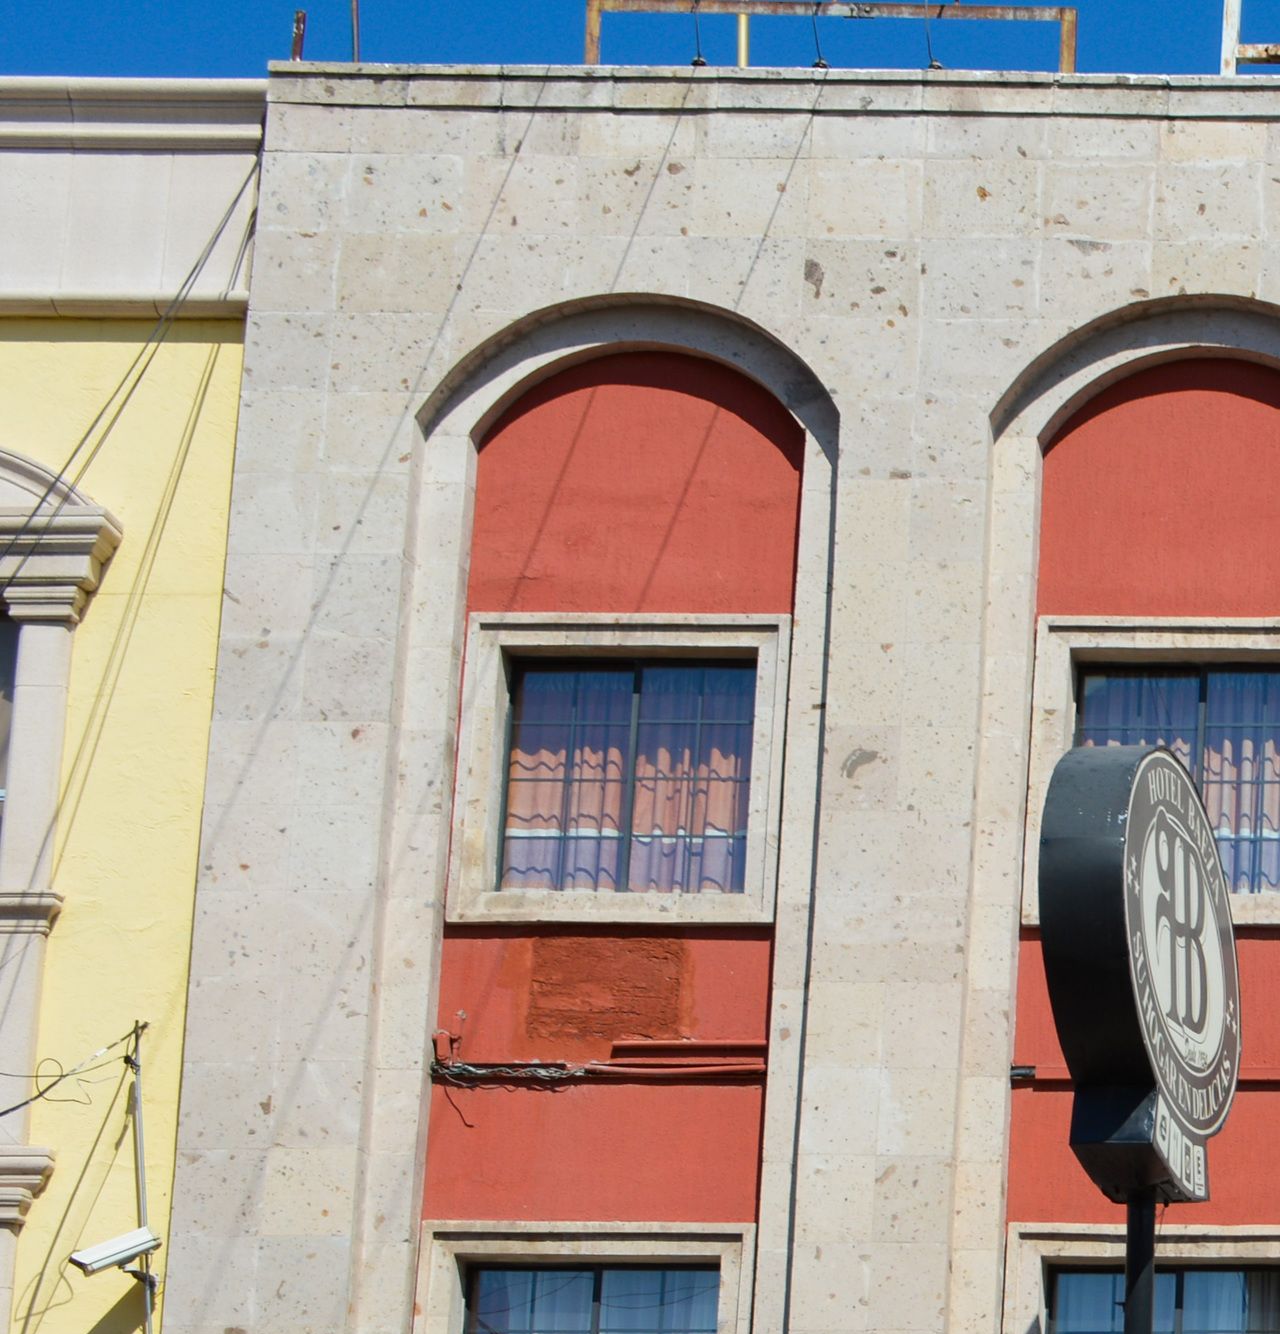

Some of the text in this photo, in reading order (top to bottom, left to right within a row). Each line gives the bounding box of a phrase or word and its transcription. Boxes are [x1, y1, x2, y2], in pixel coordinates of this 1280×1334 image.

[1148, 767, 1220, 906] HOTEL BAEZA
[1133, 931, 1147, 984] SU
[1141, 985, 1177, 1099] HOGAR
[1178, 1082, 1192, 1115] EN
[1193, 1050, 1231, 1121] DELICIAS
